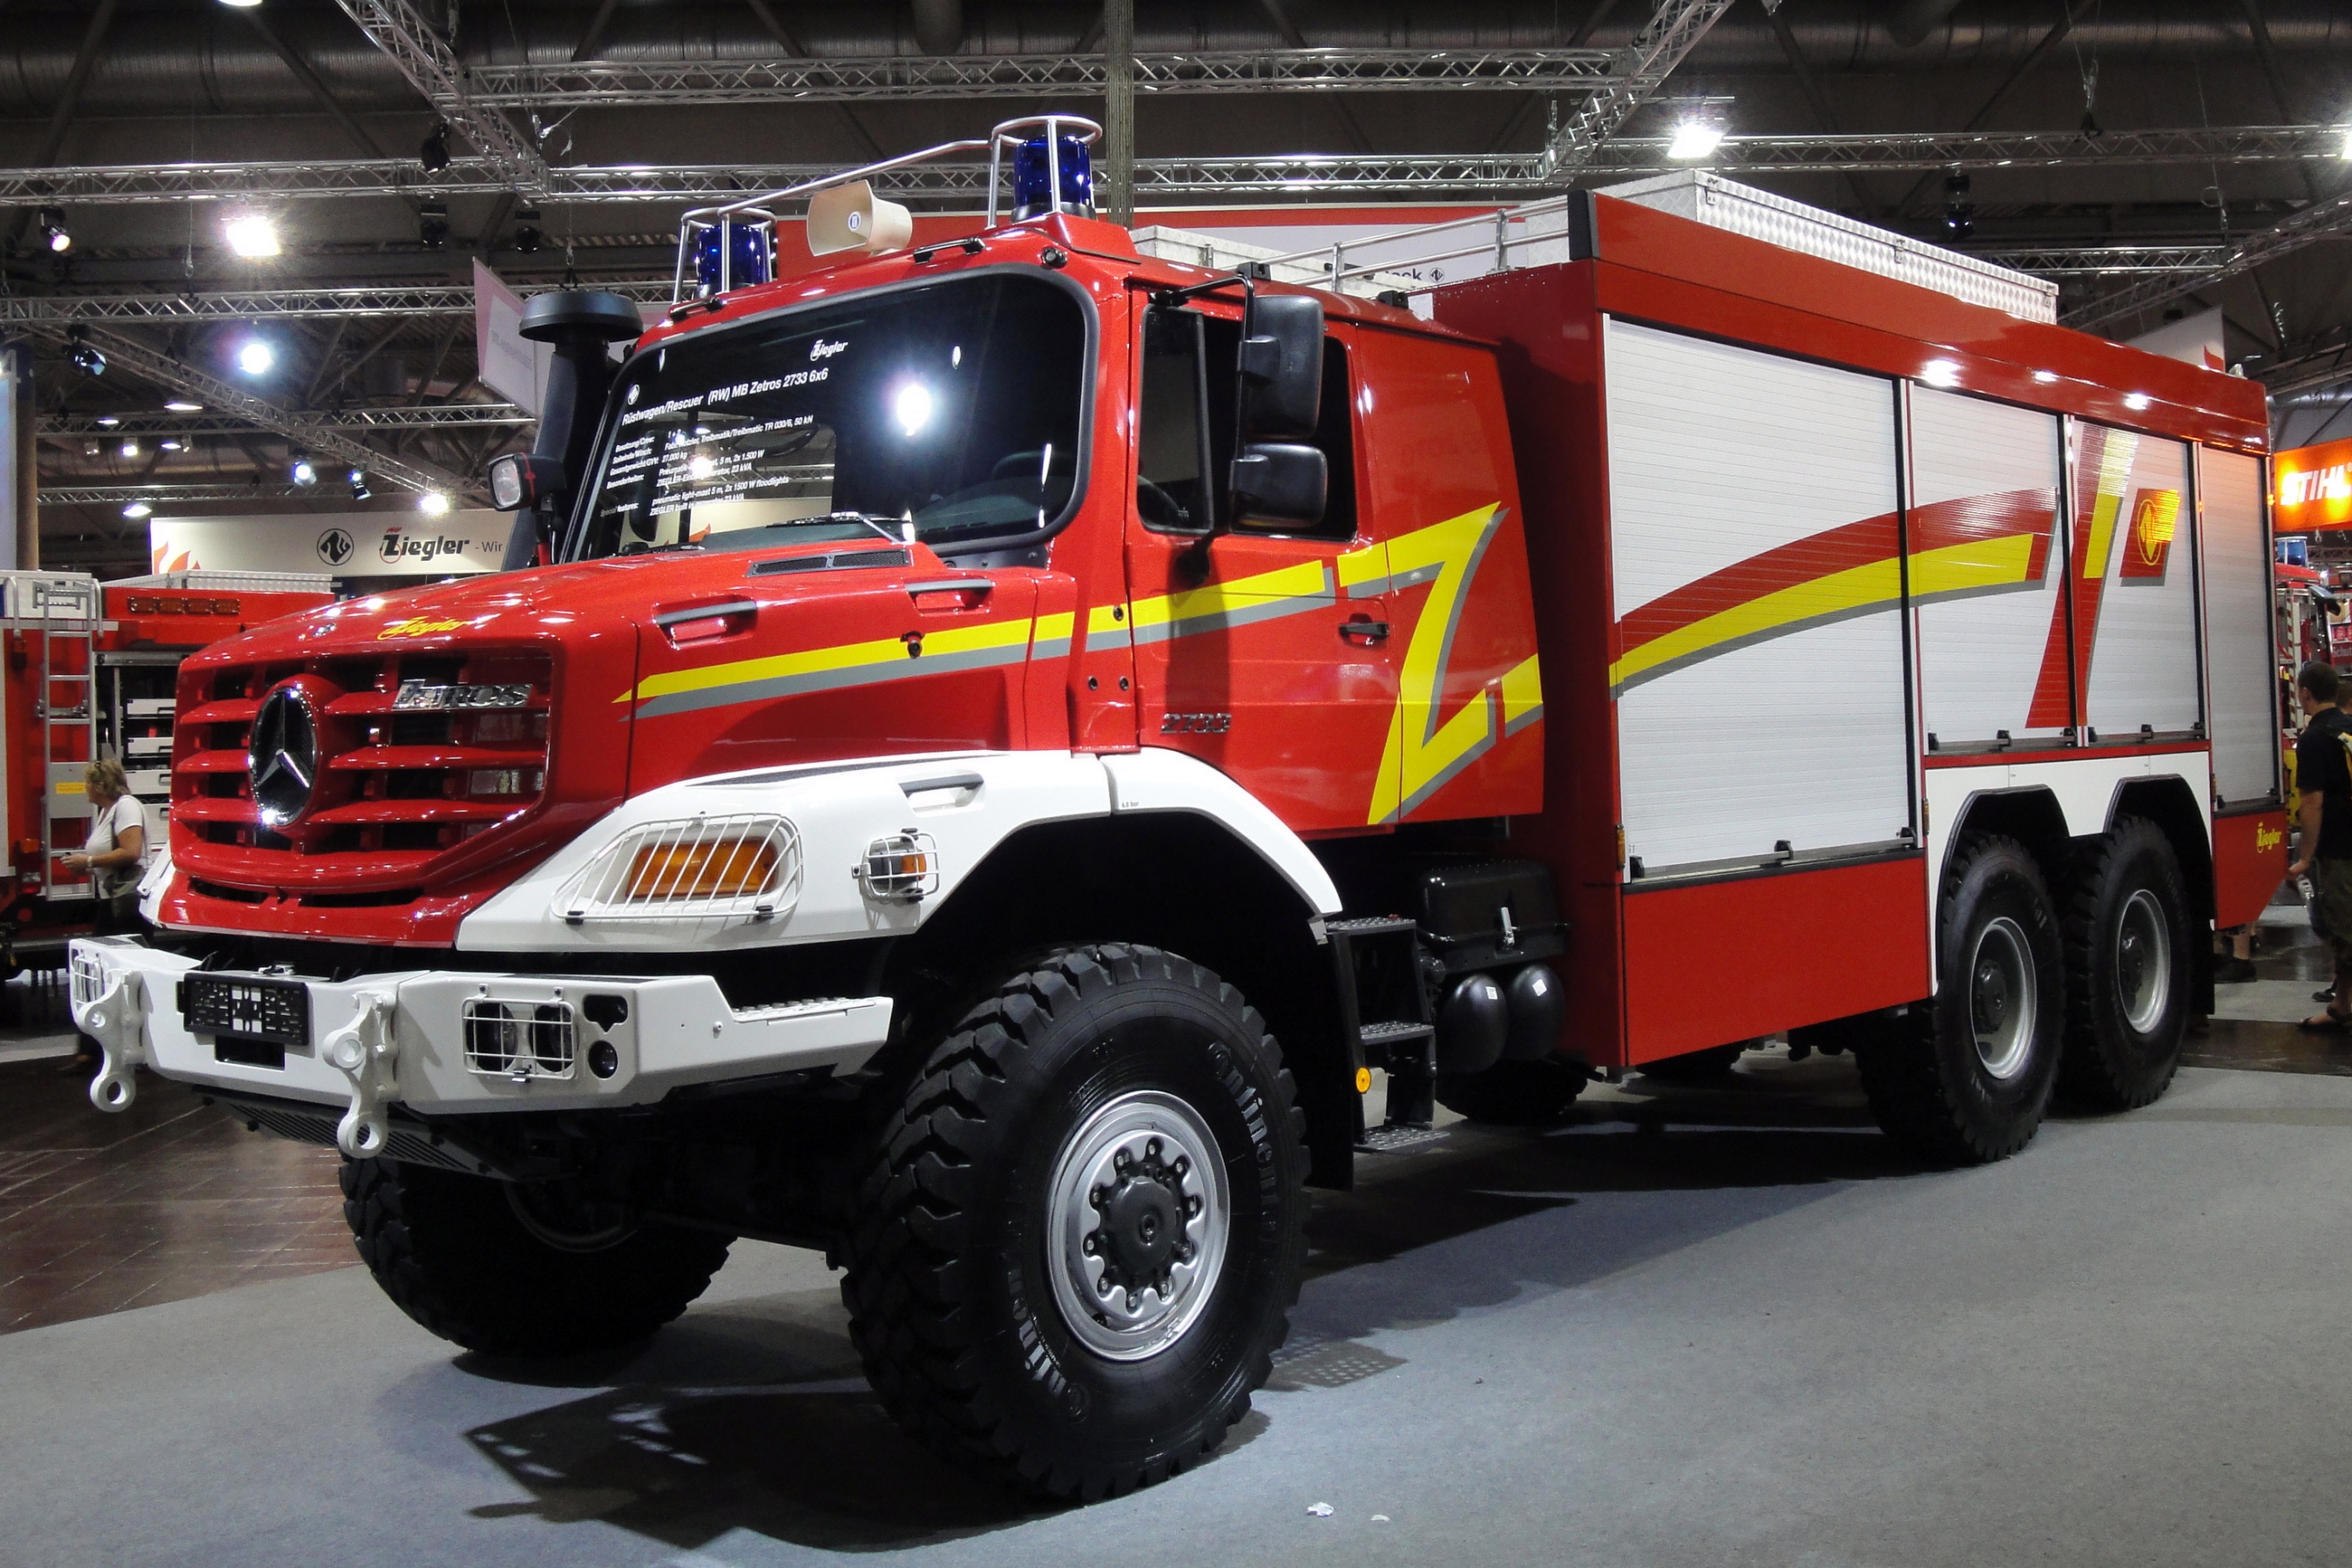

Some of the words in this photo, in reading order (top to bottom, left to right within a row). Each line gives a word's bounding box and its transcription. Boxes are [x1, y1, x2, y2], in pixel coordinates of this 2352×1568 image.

[810, 339, 848, 361] Ziegler
[622, 395, 704, 426] Rüstwagen/Rescuer
[707, 387, 731, 405] (RW)
[732, 382, 748, 398] MB
[749, 379, 781, 394] Zetros
[783, 371, 808, 388] 2733
[809, 368, 828, 382] 6x6
[765, 422, 774, 431] TR
[794, 416, 802, 426] 50
[803, 415, 814, 425] kN
[680, 451, 688, 461] kg
[757, 449, 765, 458] W
[749, 480, 756, 490] W
[2280, 464, 2352, 506] STIHL
[649, 504, 675, 517] ZIEGLER
[381, 528, 470, 564] Ziegler
[482, 541, 503, 552] Wir
[1160, 713, 1232, 733] 2733
